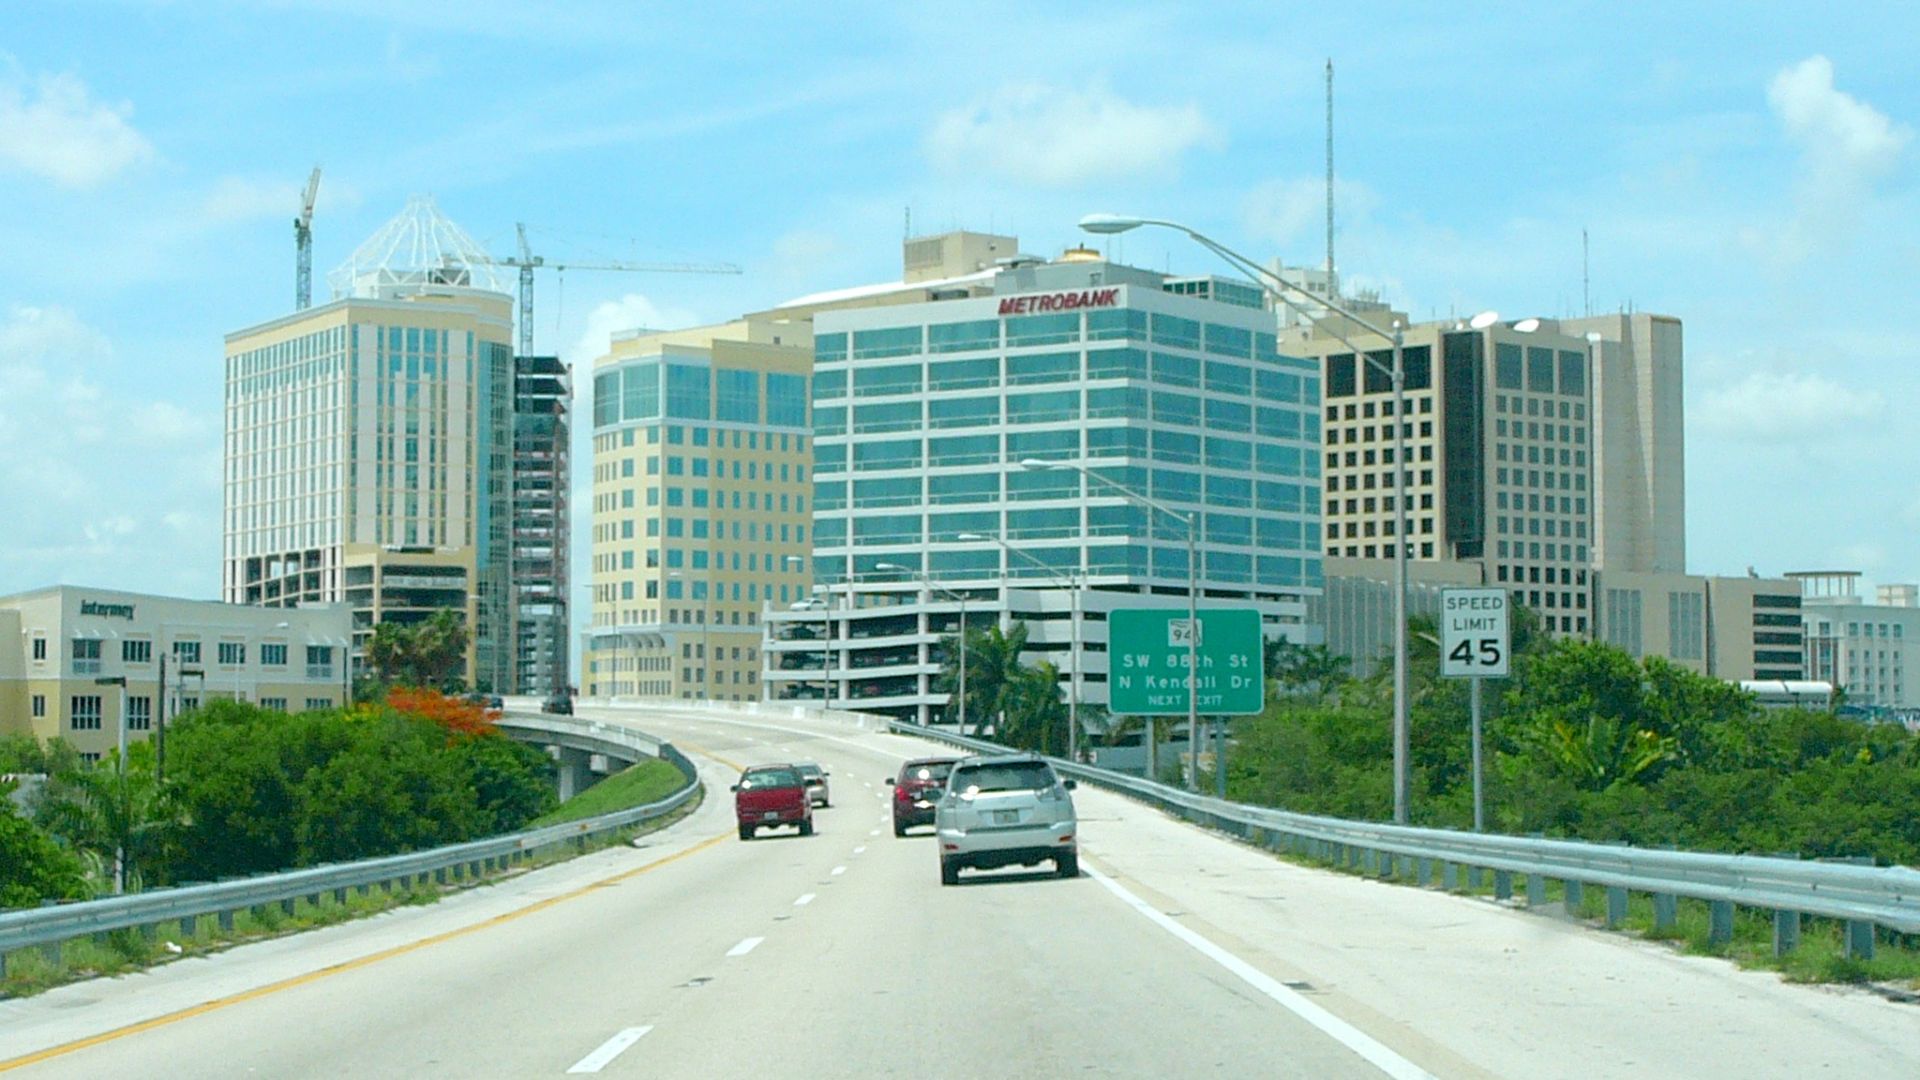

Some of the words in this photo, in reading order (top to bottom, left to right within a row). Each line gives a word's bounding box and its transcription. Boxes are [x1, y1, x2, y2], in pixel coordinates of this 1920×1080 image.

[997, 288, 1119, 315] METROBANK
[1447, 597, 1503, 610] SPEED
[1453, 618, 1497, 631] LIMIT
[1449, 639, 1501, 666] 45
[1122, 654, 1150, 668] SW
[1229, 654, 1248, 668] St
[1119, 676, 1131, 689] N
[1231, 675, 1252, 689] Dr
[1148, 694, 1182, 706] NEXT
[1196, 694, 1223, 706] EXIT
